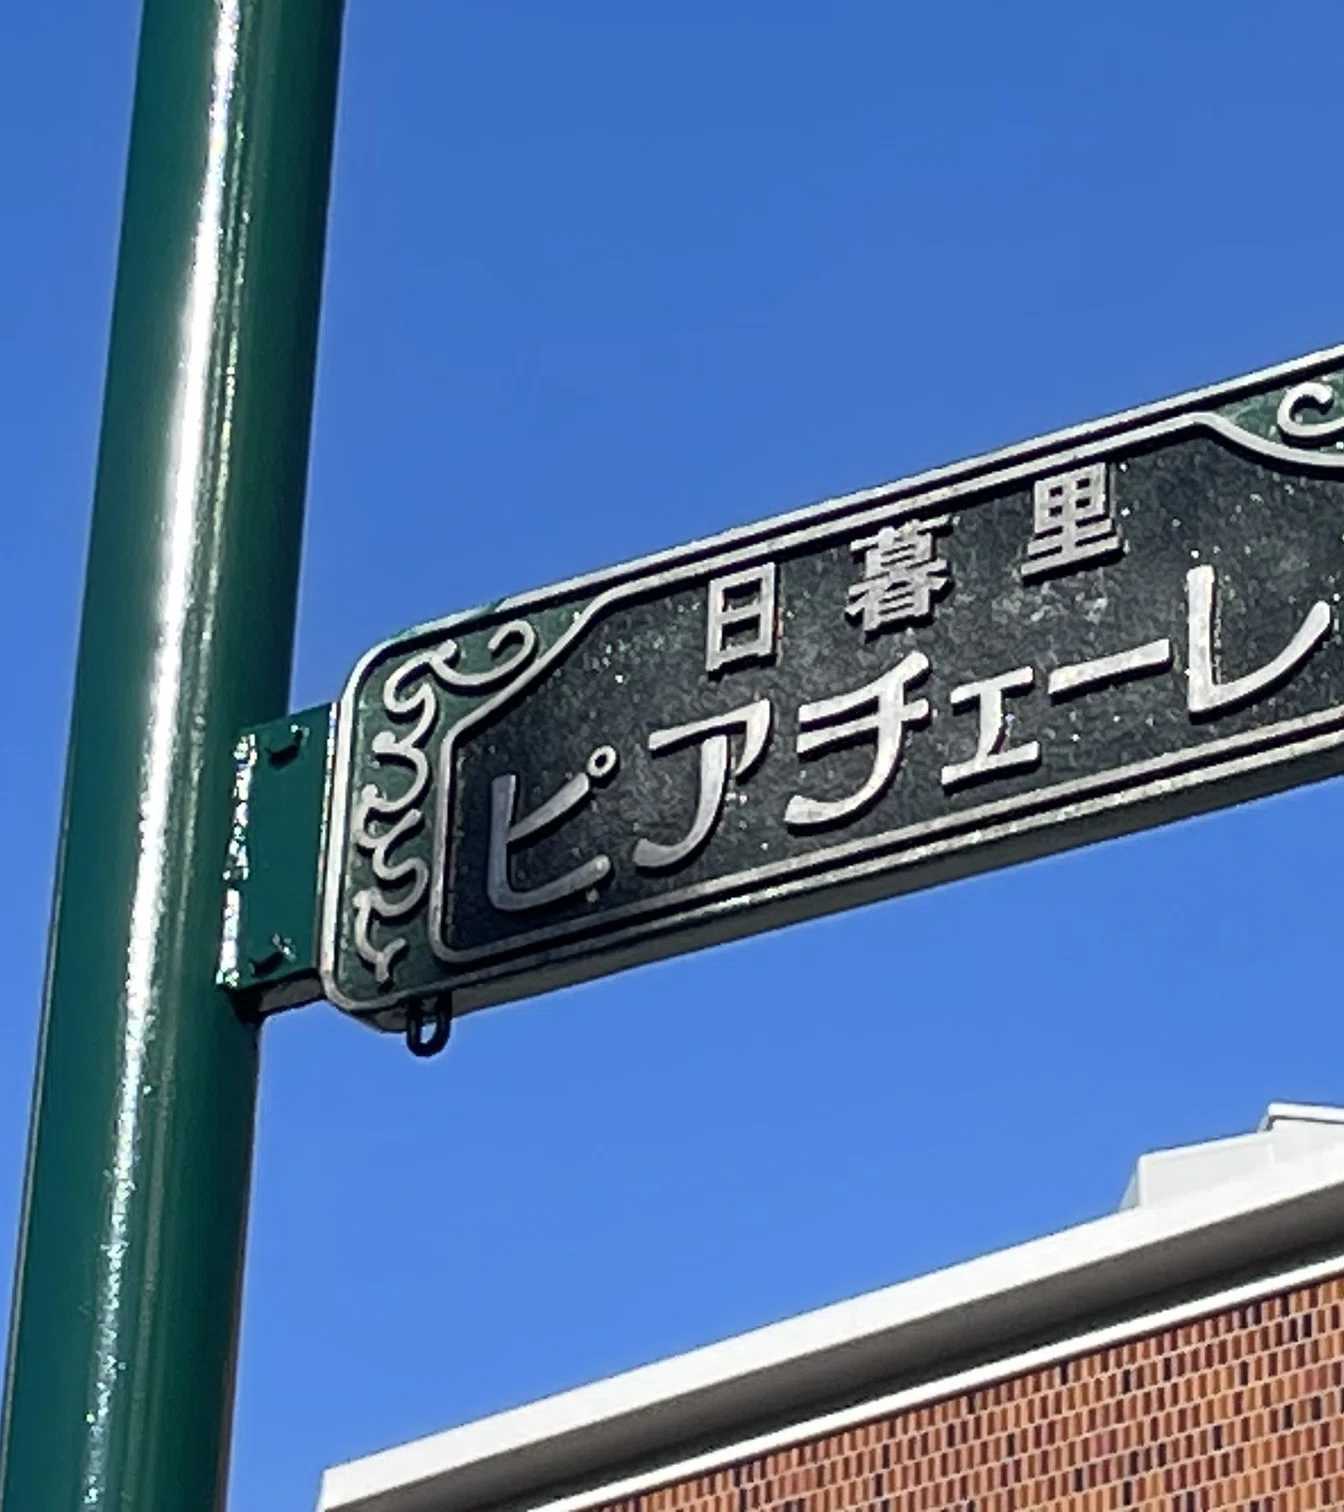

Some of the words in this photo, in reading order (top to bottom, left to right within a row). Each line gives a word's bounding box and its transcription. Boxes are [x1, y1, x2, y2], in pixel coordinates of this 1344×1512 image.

[705, 462, 1124, 672] 日暮里
[488, 565, 1332, 911] ピアチェーレ
